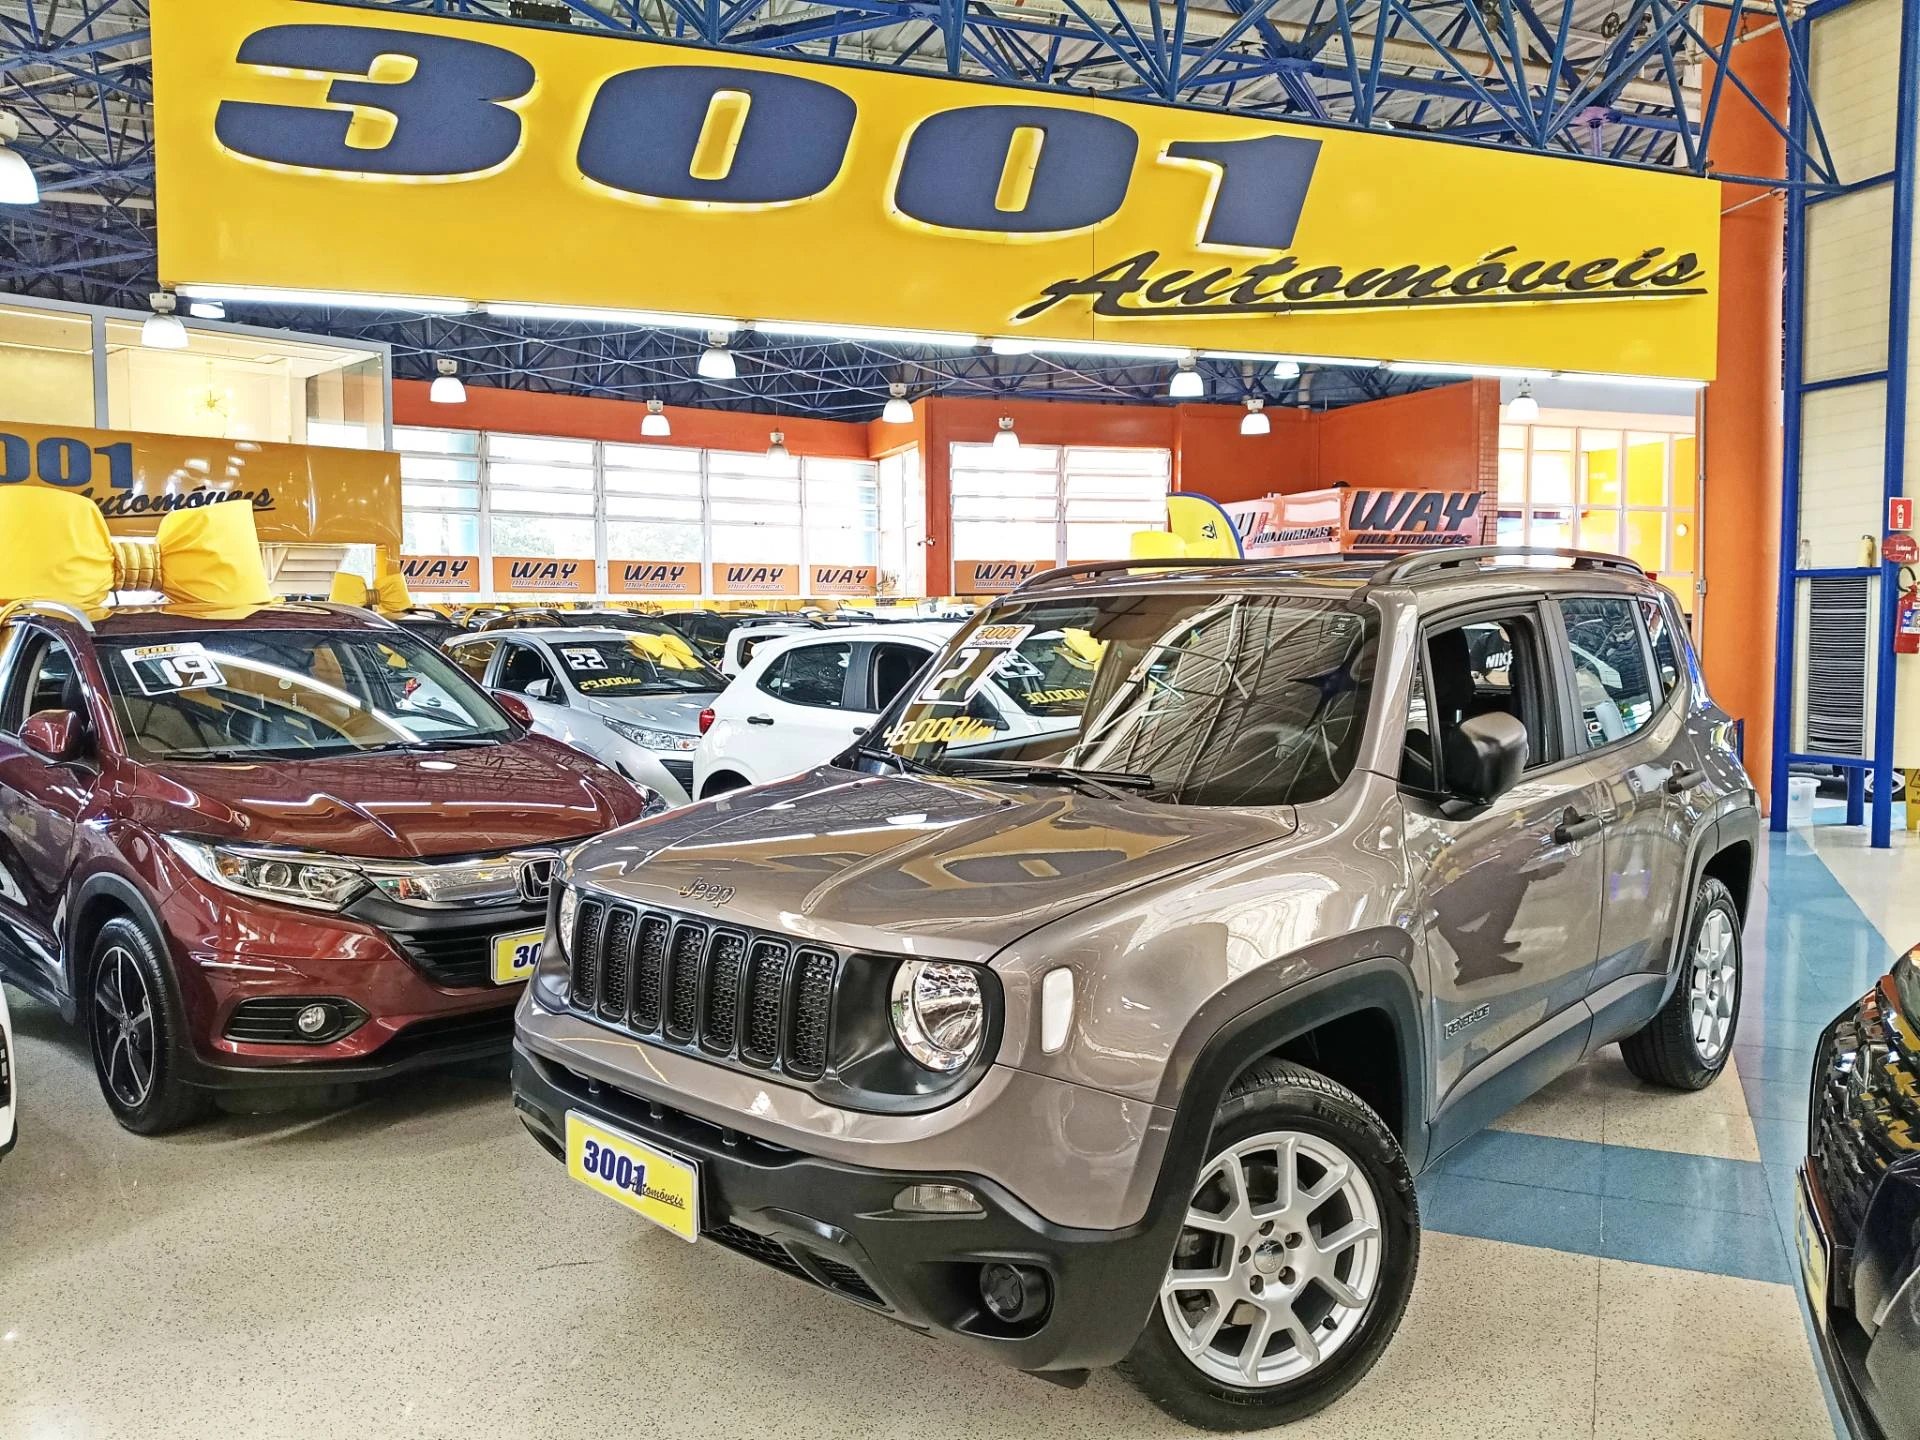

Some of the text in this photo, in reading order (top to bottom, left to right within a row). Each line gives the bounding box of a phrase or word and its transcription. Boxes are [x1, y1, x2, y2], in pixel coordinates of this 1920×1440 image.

[214, 23, 1323, 252] 3001
[1011, 246, 1706, 319] Automóveis
[1349, 491, 1480, 531] WAY
[400, 560, 469, 577] WAY
[511, 562, 578, 579] WAY
[624, 565, 685, 581] WAY
[728, 568, 784, 582] WAY
[817, 569, 868, 583] WAY
[975, 564, 1035, 579] WAY
[160, 655, 222, 686] 19
[566, 653, 606, 669] 22
[882, 716, 996, 747] 48.000Km
[679, 875, 736, 908] Jeep
[583, 1139, 646, 1197] 3001
